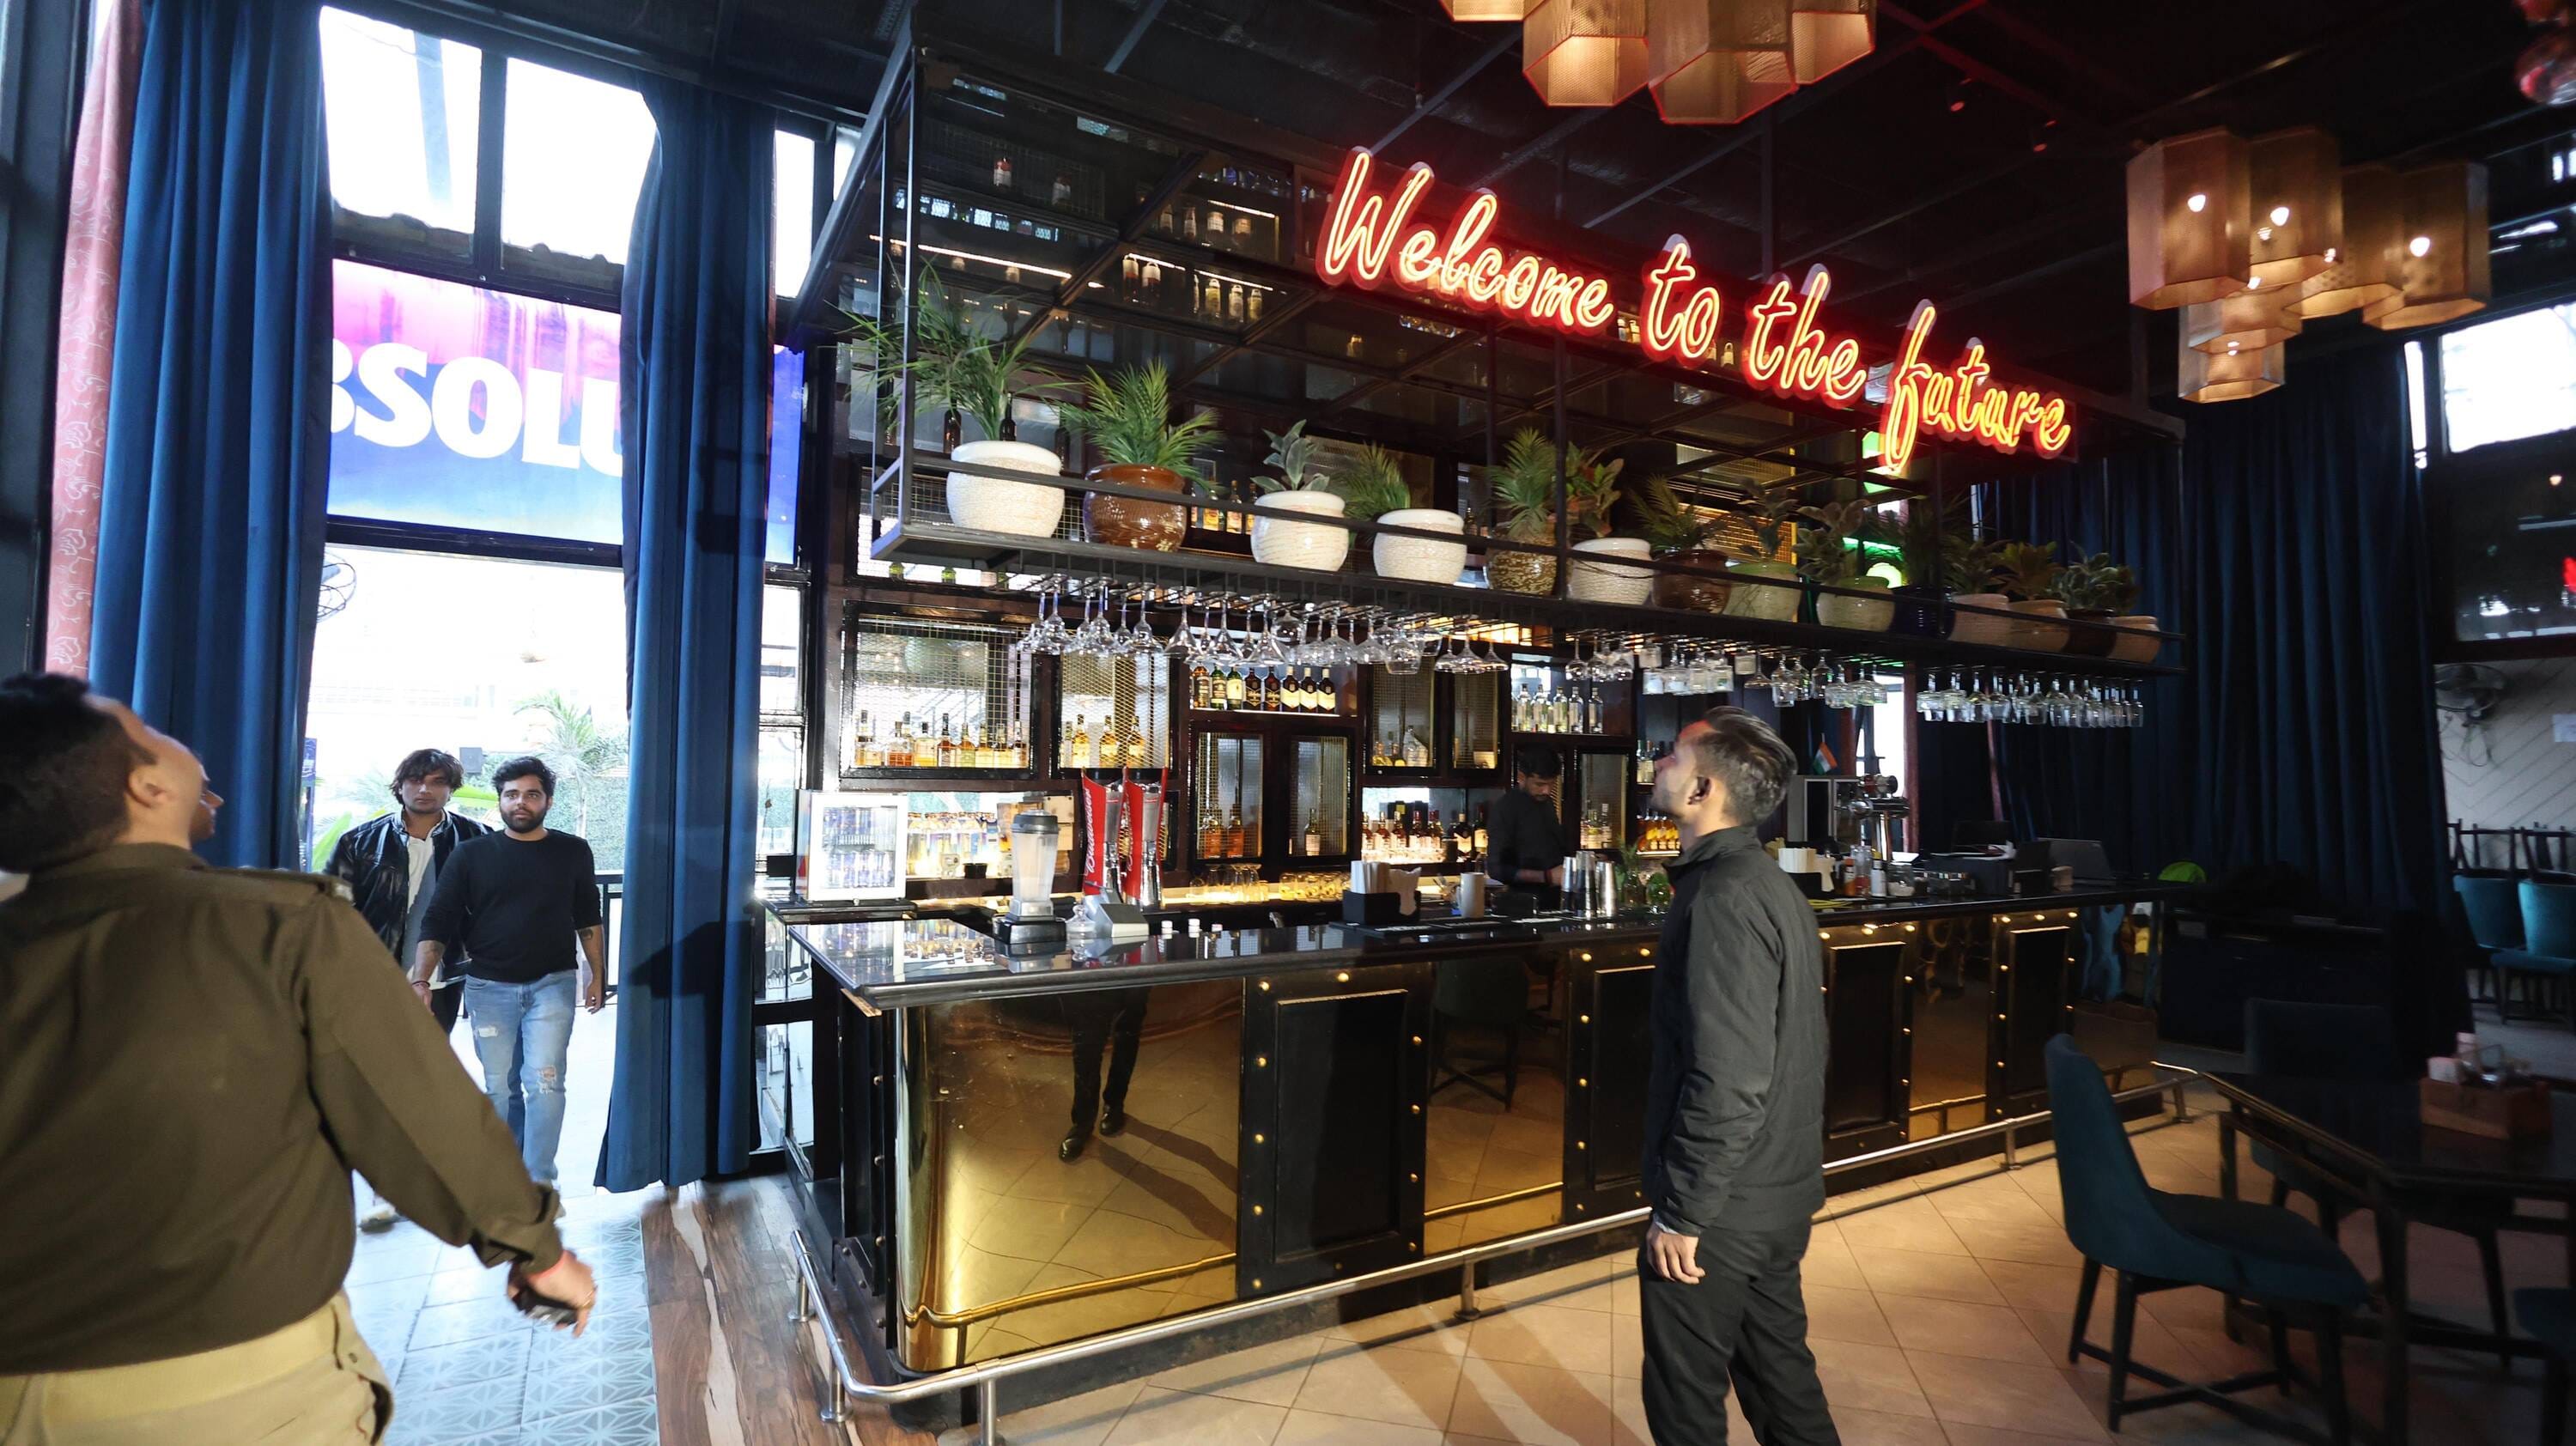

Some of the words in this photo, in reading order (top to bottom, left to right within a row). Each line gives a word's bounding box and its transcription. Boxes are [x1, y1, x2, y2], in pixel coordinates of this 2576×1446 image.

[1325, 151, 1614, 328] Welcome
[1647, 242, 1720, 358] to
[1748, 270, 1867, 400] the
[1885, 306, 2072, 475] future
